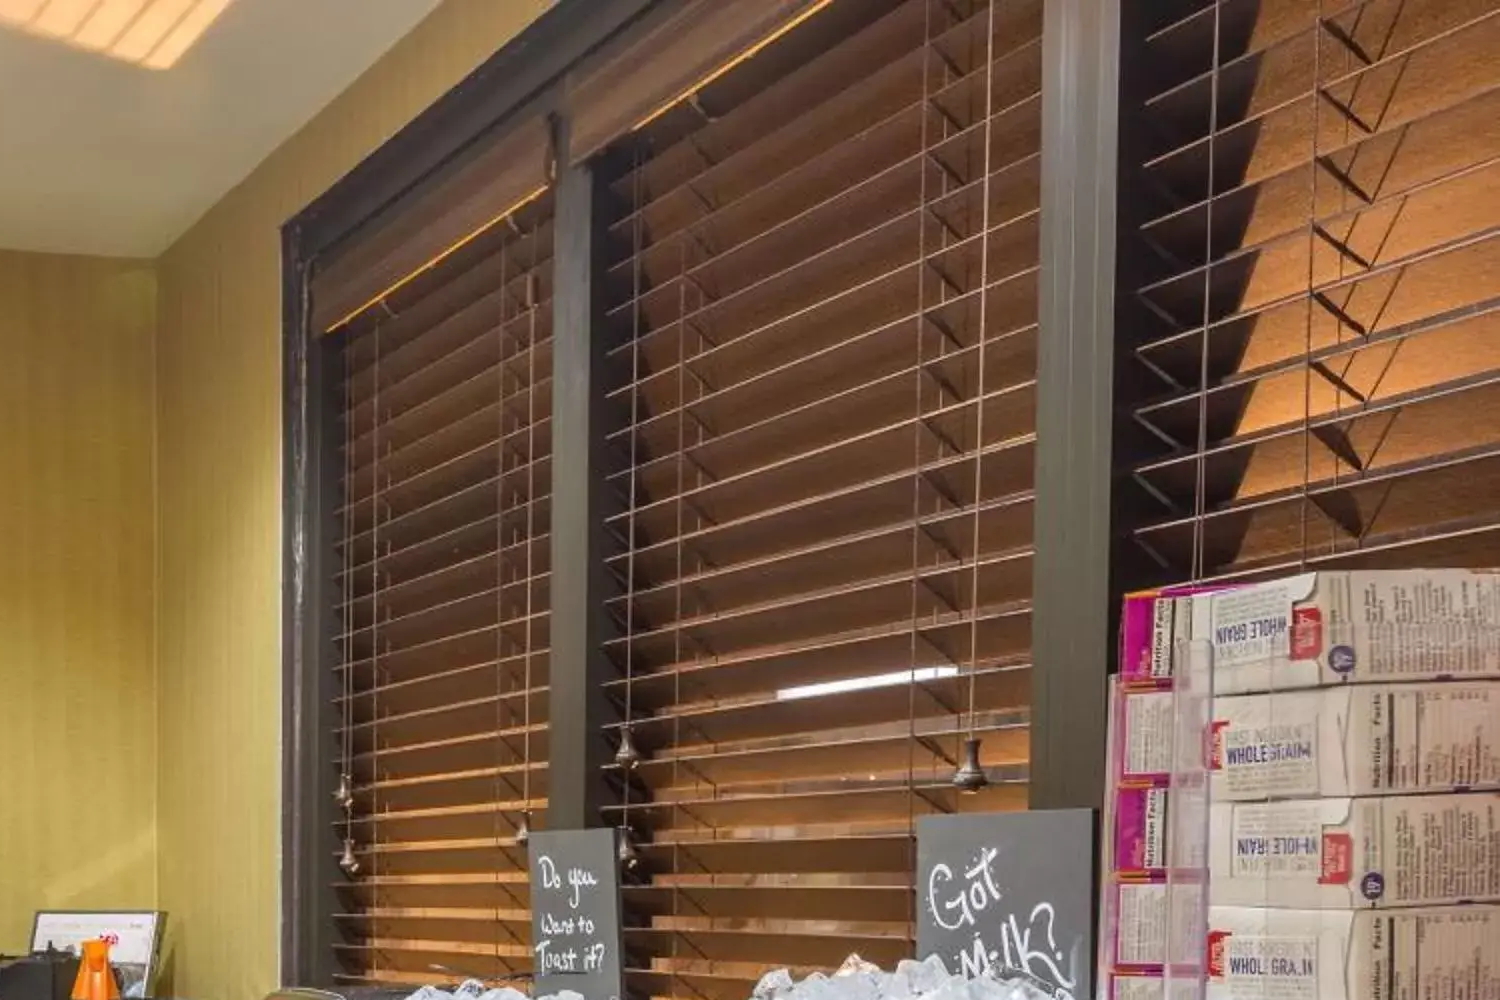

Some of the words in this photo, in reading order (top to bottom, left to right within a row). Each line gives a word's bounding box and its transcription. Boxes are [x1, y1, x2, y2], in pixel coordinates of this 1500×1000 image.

[1155, 599, 1166, 629] Facts
[1215, 624, 1248, 646] GRAIN
[1250, 616, 1287, 642] WHOLE
[1227, 744, 1267, 765] WHOLE
[538, 855, 561, 889] Do
[567, 867, 599, 908] you
[928, 847, 1001, 930] Got
[577, 915, 595, 935] to
[535, 939, 578, 977] Toast
[583, 943, 606, 974] it?
